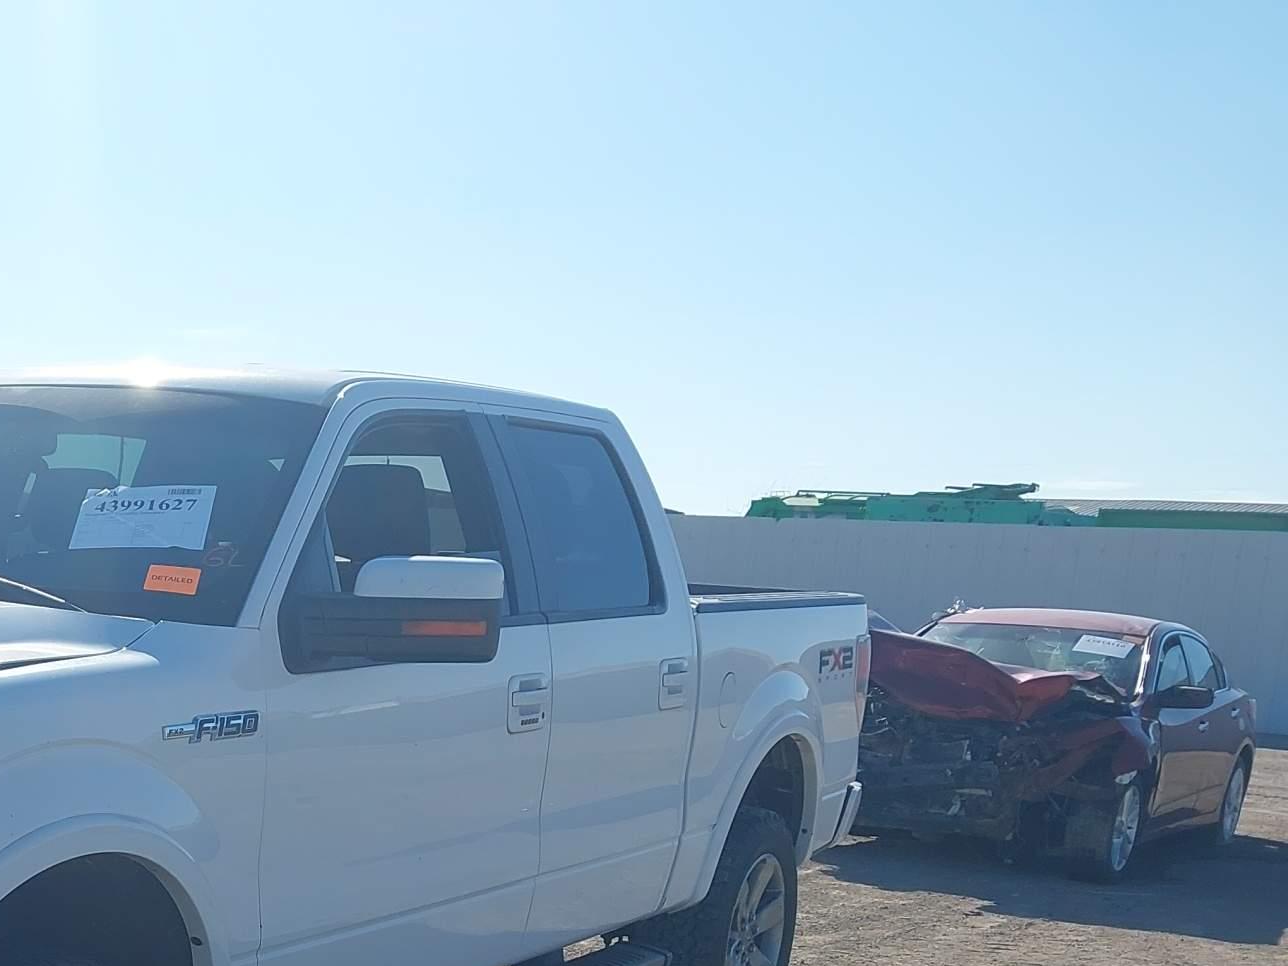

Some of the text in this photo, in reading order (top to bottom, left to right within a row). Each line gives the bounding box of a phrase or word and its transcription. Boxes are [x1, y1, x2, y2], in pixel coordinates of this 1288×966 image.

[94, 498, 198, 513] 43991627
[151, 573, 194, 585] DETAILED
[818, 647, 854, 674] FX2
